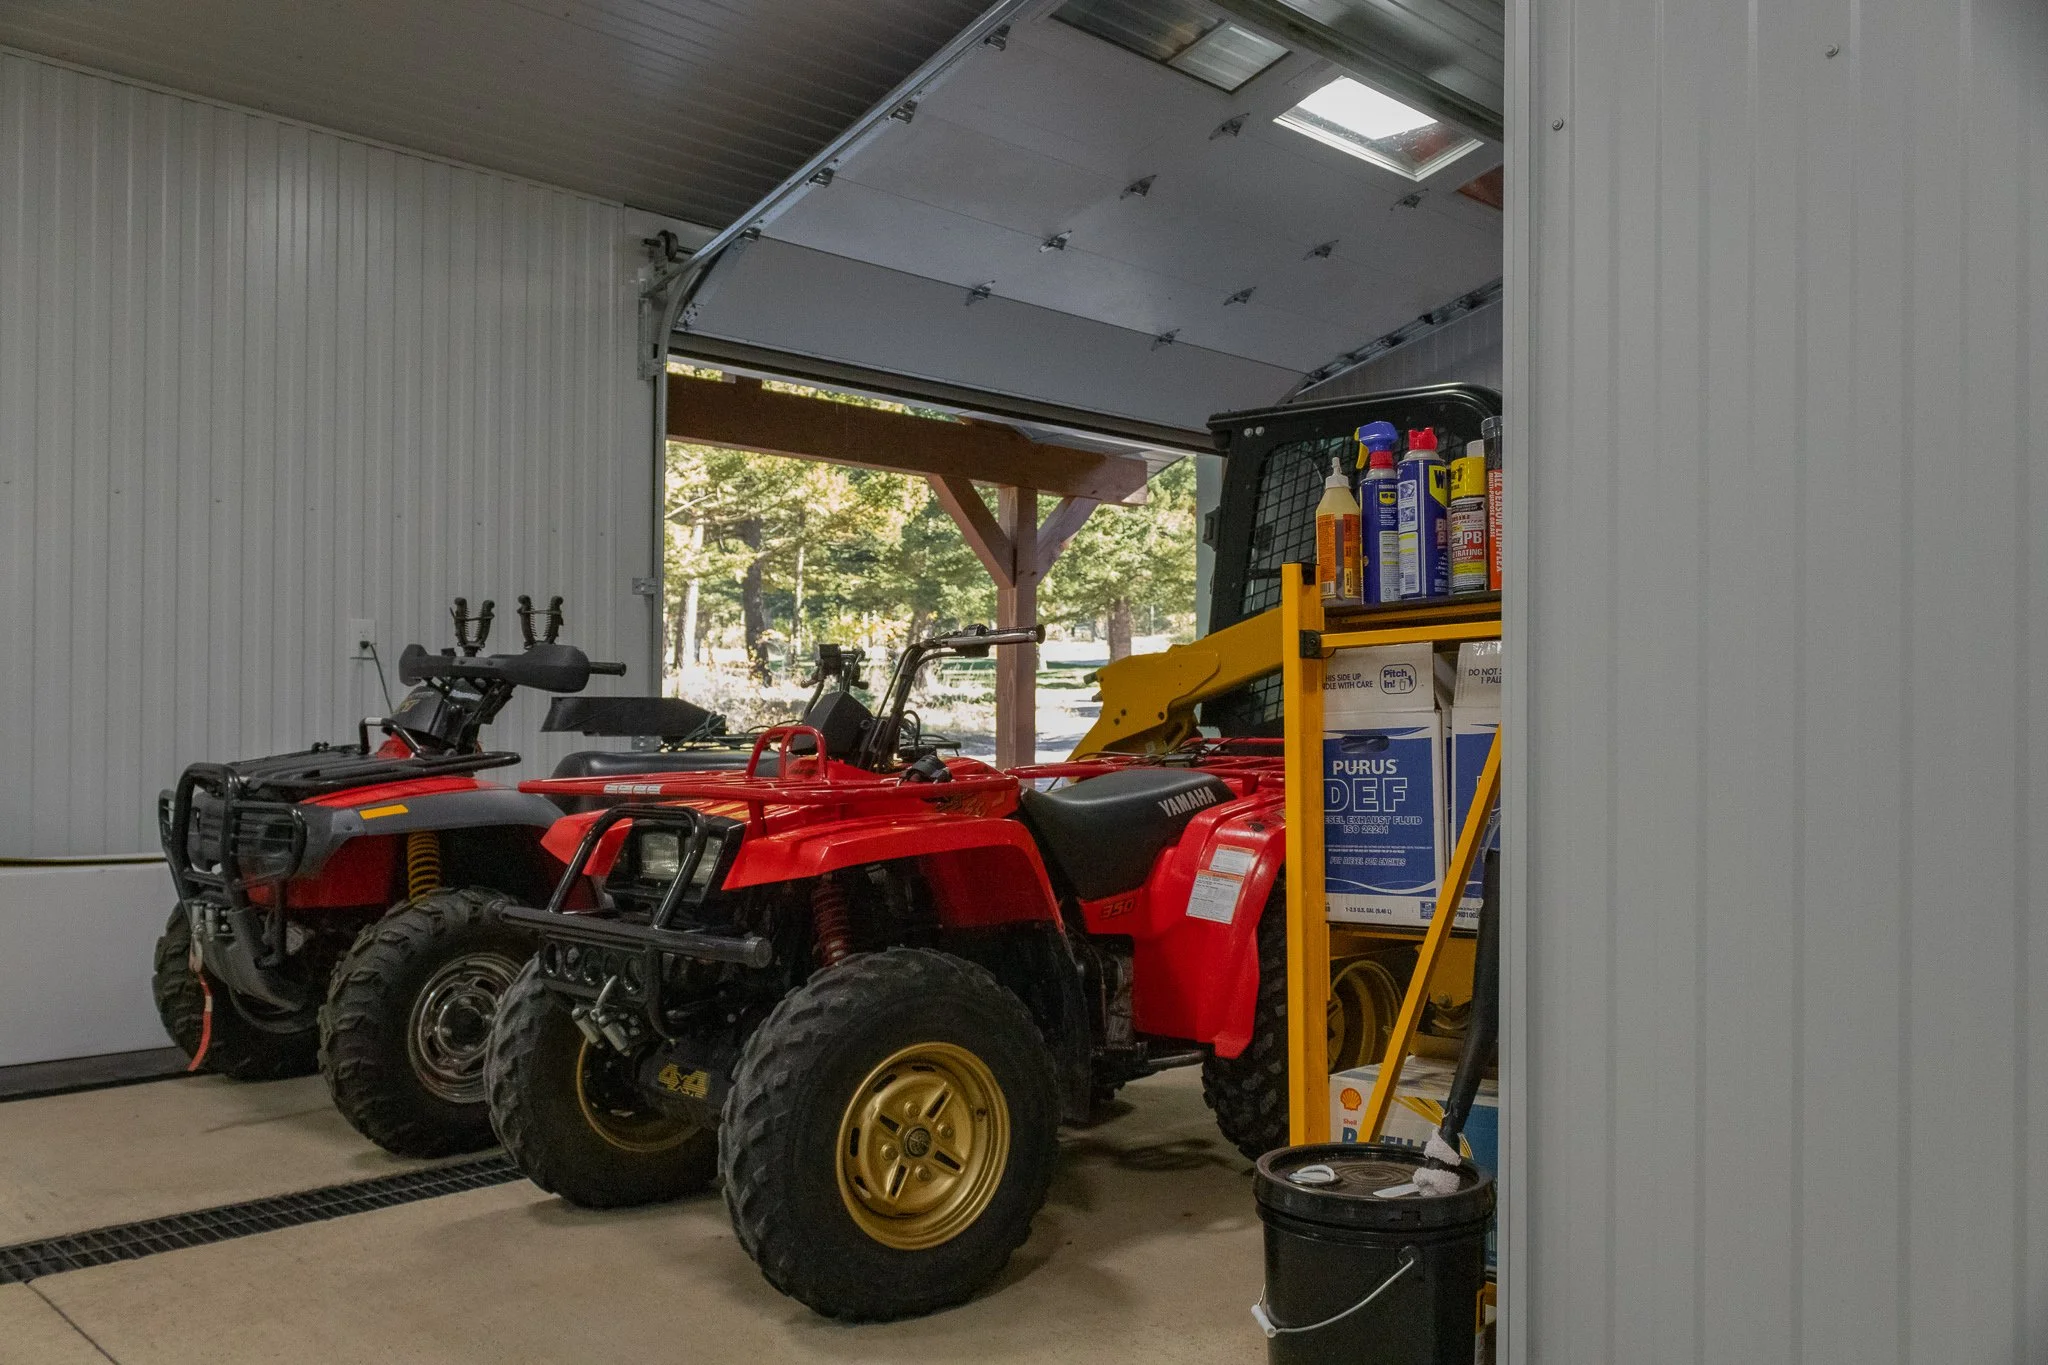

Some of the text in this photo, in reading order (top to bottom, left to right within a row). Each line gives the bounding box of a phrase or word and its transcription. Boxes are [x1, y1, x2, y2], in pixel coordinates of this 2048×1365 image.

[1494, 472, 1503, 487] ALL
[1495, 490, 1503, 525] SEASON
[1463, 531, 1483, 545] PB
[1383, 669, 1407, 678] Pitch
[1468, 667, 1498, 676] DO NOT
[1337, 673, 1351, 681] SIDE
[1338, 681, 1354, 689] WITH
[1356, 680, 1373, 688] CARE
[1384, 680, 1395, 689] In!
[1333, 759, 1397, 775] PURUS
[1323, 777, 1408, 813] DEF
[1158, 786, 1217, 817] YAMAHA
[1324, 815, 1423, 826] ESEL EXHAUST FLUID
[1344, 825, 1389, 834] ISO 22241
[1343, 1118, 1358, 1126] Shell
